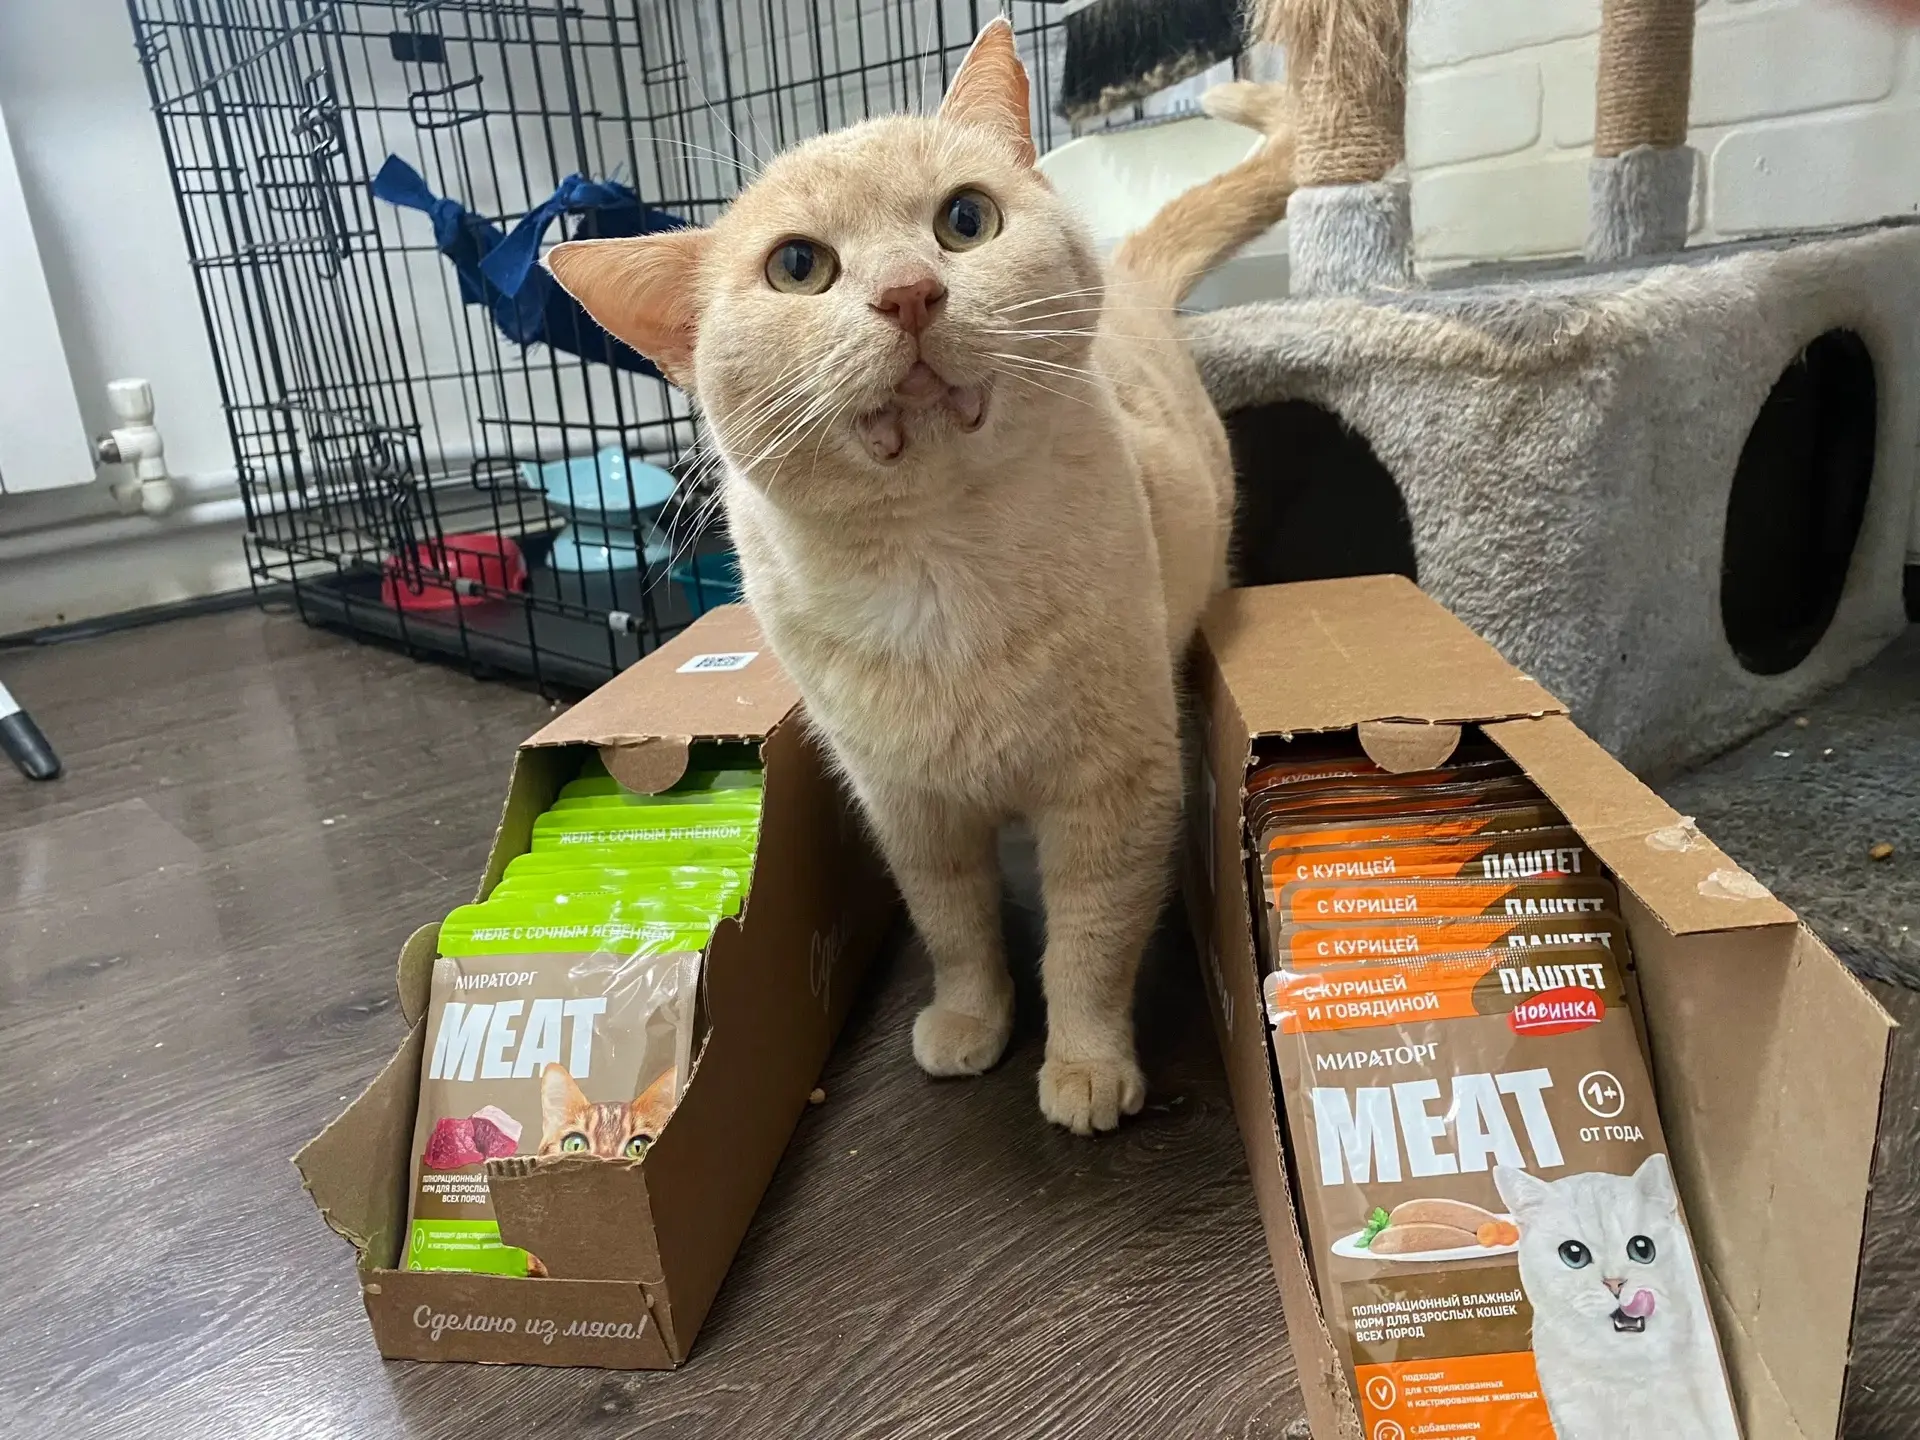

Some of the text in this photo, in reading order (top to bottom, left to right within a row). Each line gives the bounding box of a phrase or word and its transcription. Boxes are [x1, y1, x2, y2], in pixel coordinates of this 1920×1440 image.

[560, 825, 741, 844] ЖЕЛЕ С СОЧНЫМ ЯГНЁНКОМ
[1296, 856, 1396, 879] С КУРИЦЕЙ
[1482, 848, 1583, 878] ПАШТЕТ
[1317, 897, 1418, 914] С КУРИЦЕЙ
[471, 928, 510, 942] ЖЕЛЕ
[513, 928, 522, 940] С
[526, 925, 588, 940] СОЧНЫМ
[1317, 933, 1419, 956] С КУРИЦЕЙ
[454, 971, 538, 990] МИРАТОРГ
[1321, 974, 1407, 999] КУРИЦЕЙ
[1500, 964, 1606, 995] ПАШТЕТ
[1307, 994, 1440, 1021] И ГОВЯДИНОЙ
[1514, 1002, 1597, 1023] НОВИНКА
[429, 998, 607, 1082] MEAT
[1316, 1042, 1438, 1072] МИРАТОРГ
[1586, 1081, 1617, 1106] 1+
[1311, 1067, 1564, 1186] MEAT
[1579, 1124, 1644, 1144] ОТ ГОДА
[451, 1185, 490, 1193] ВЗРОСЛЫХ
[461, 1195, 485, 1204] ПОРОД
[1352, 1288, 1522, 1317] ПОЛНОРАЦИОННЫЙ ВЛАЖНЫЙ
[413, 1304, 648, 1344] Сделано из мяса!
[1354, 1305, 1518, 1330] КОРМ ДЛЯ ВЗРОСЛЫХ КОШЕК
[1356, 1324, 1425, 1342] ВСЕХ ПОРОД
